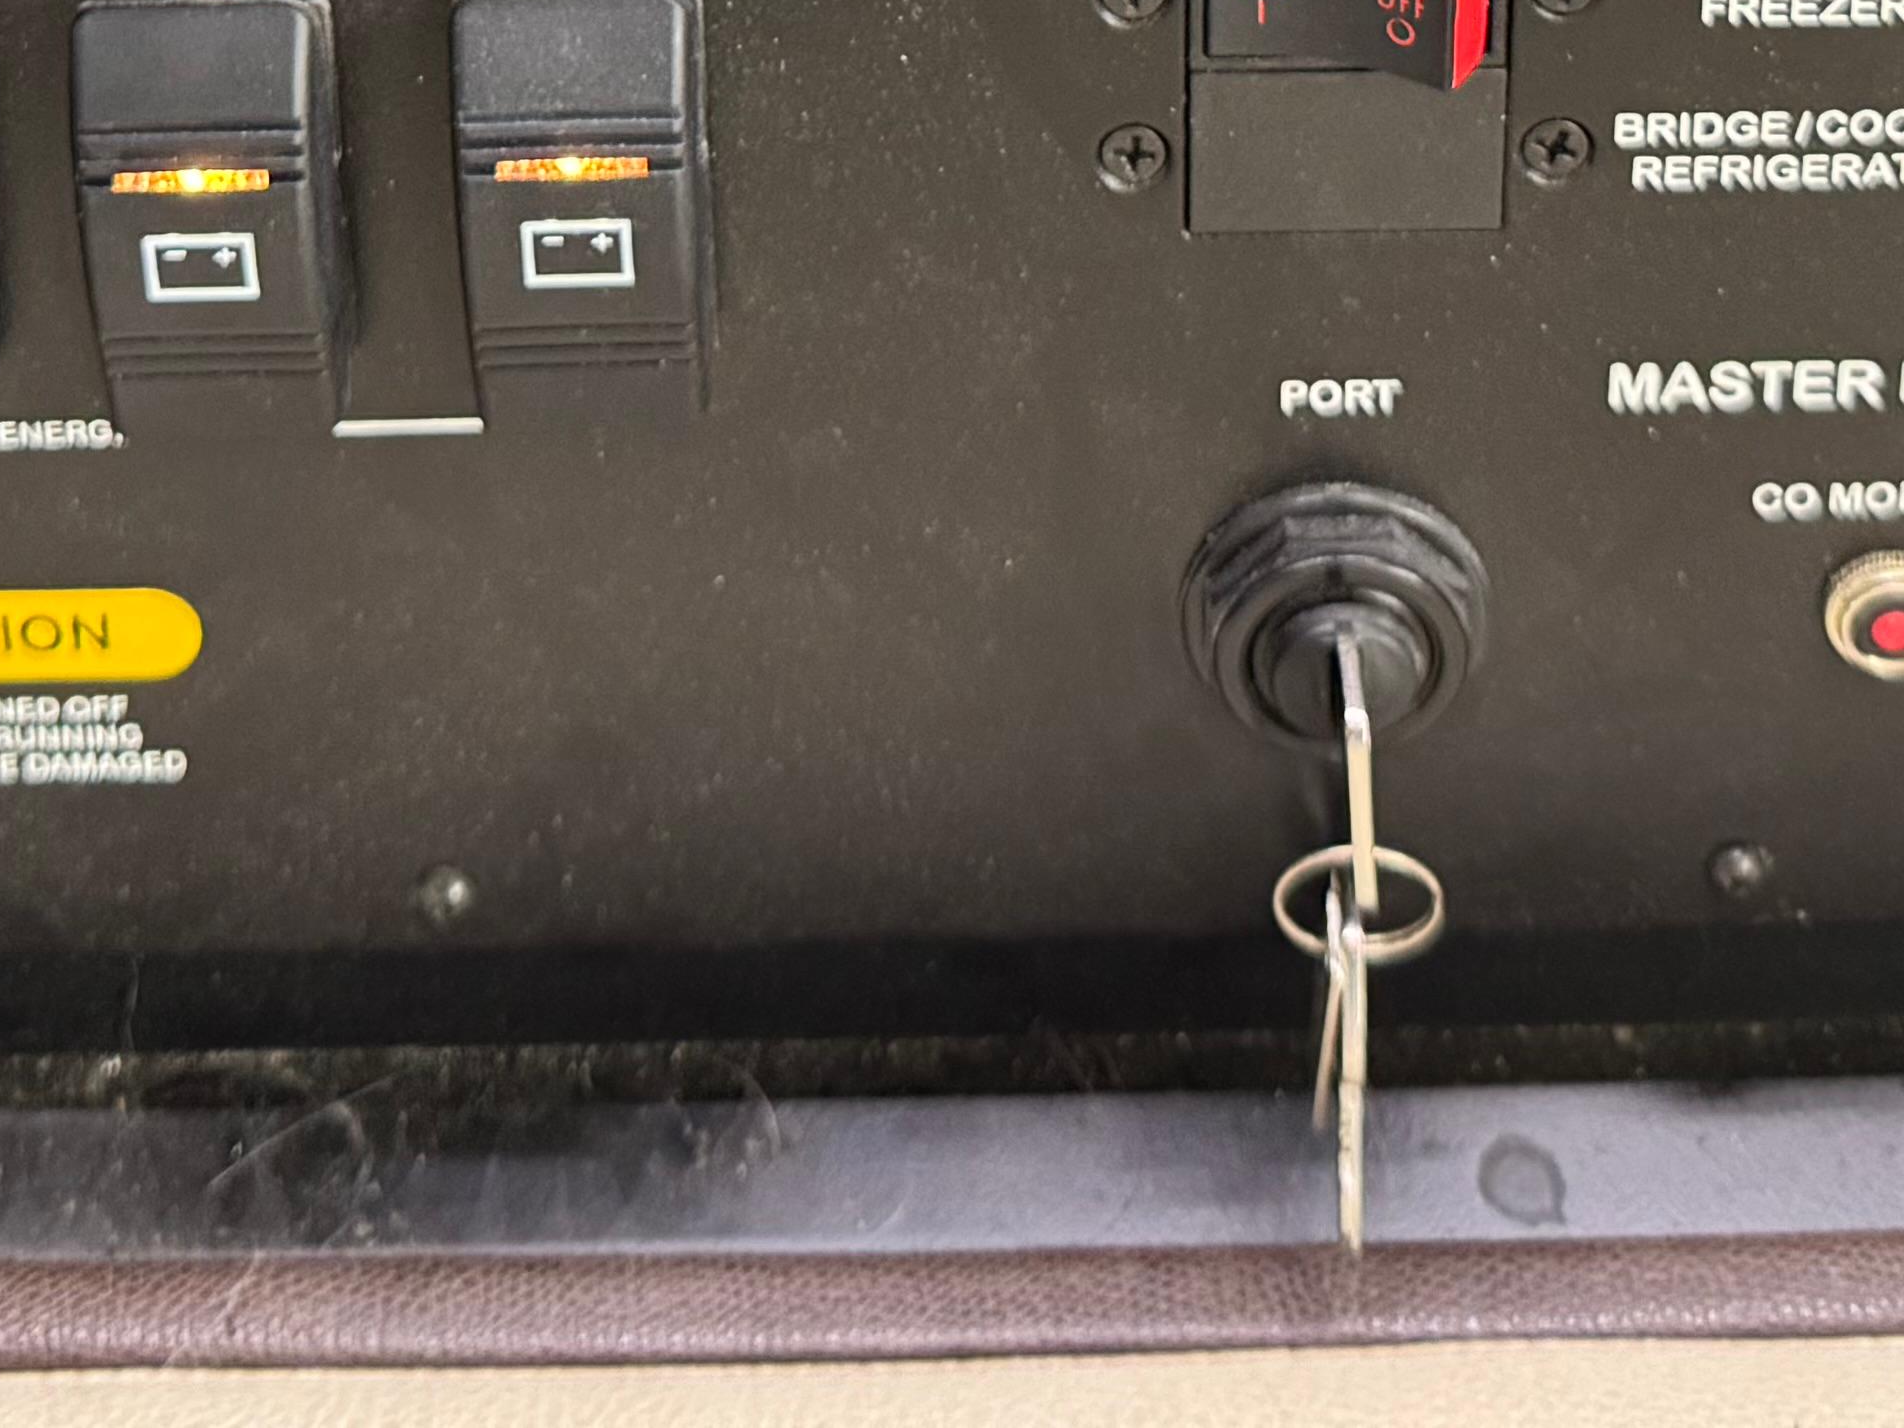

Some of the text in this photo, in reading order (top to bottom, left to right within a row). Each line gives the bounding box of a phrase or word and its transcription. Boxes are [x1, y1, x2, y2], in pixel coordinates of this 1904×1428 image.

[1280, 378, 1402, 416] PORT
[1608, 359, 1884, 412] MASTER
[1752, 482, 1822, 520] CO
[62, 694, 130, 722] OFF
[21, 750, 189, 783] DAMAGED
